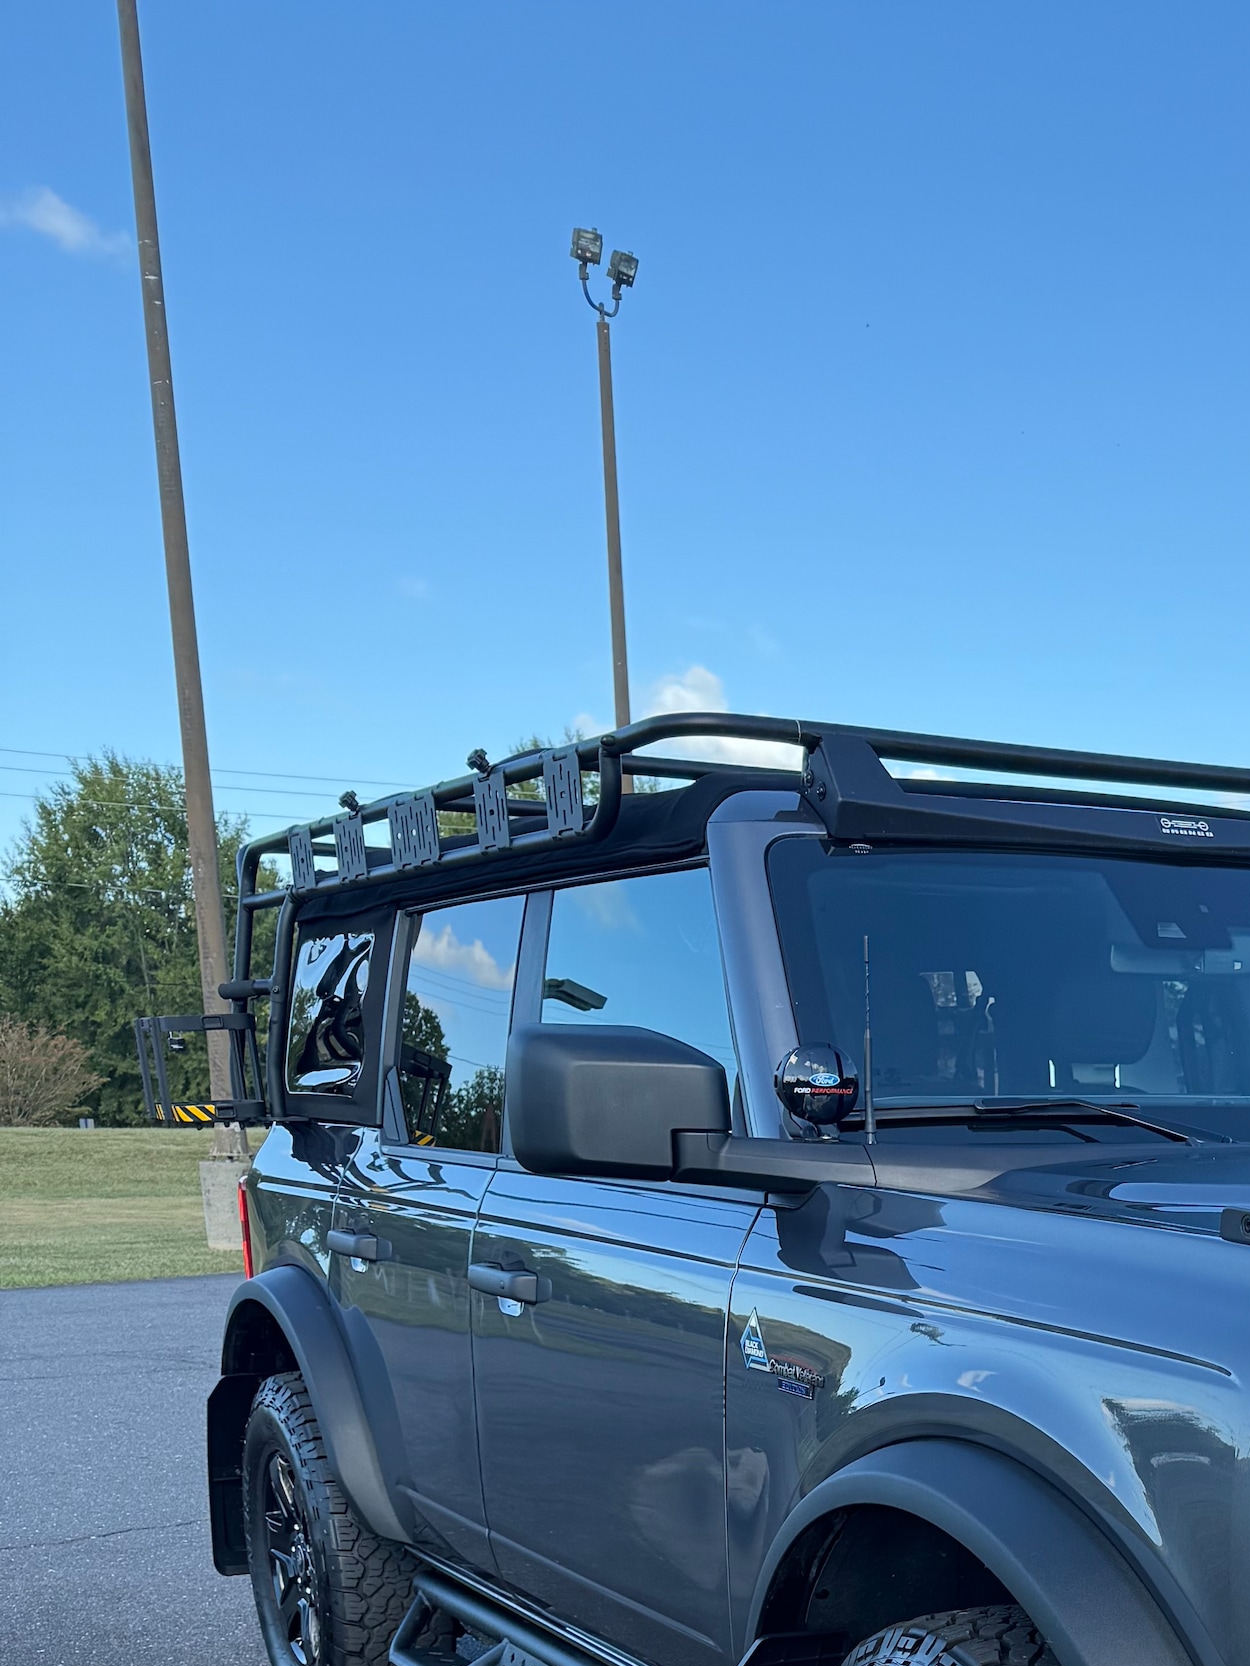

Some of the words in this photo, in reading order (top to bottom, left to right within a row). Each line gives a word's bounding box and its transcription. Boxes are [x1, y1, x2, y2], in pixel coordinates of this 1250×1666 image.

[811, 1074, 837, 1086] Ford
[745, 1340, 759, 1349] BLACK
[745, 1346, 764, 1358] DIAMOND
